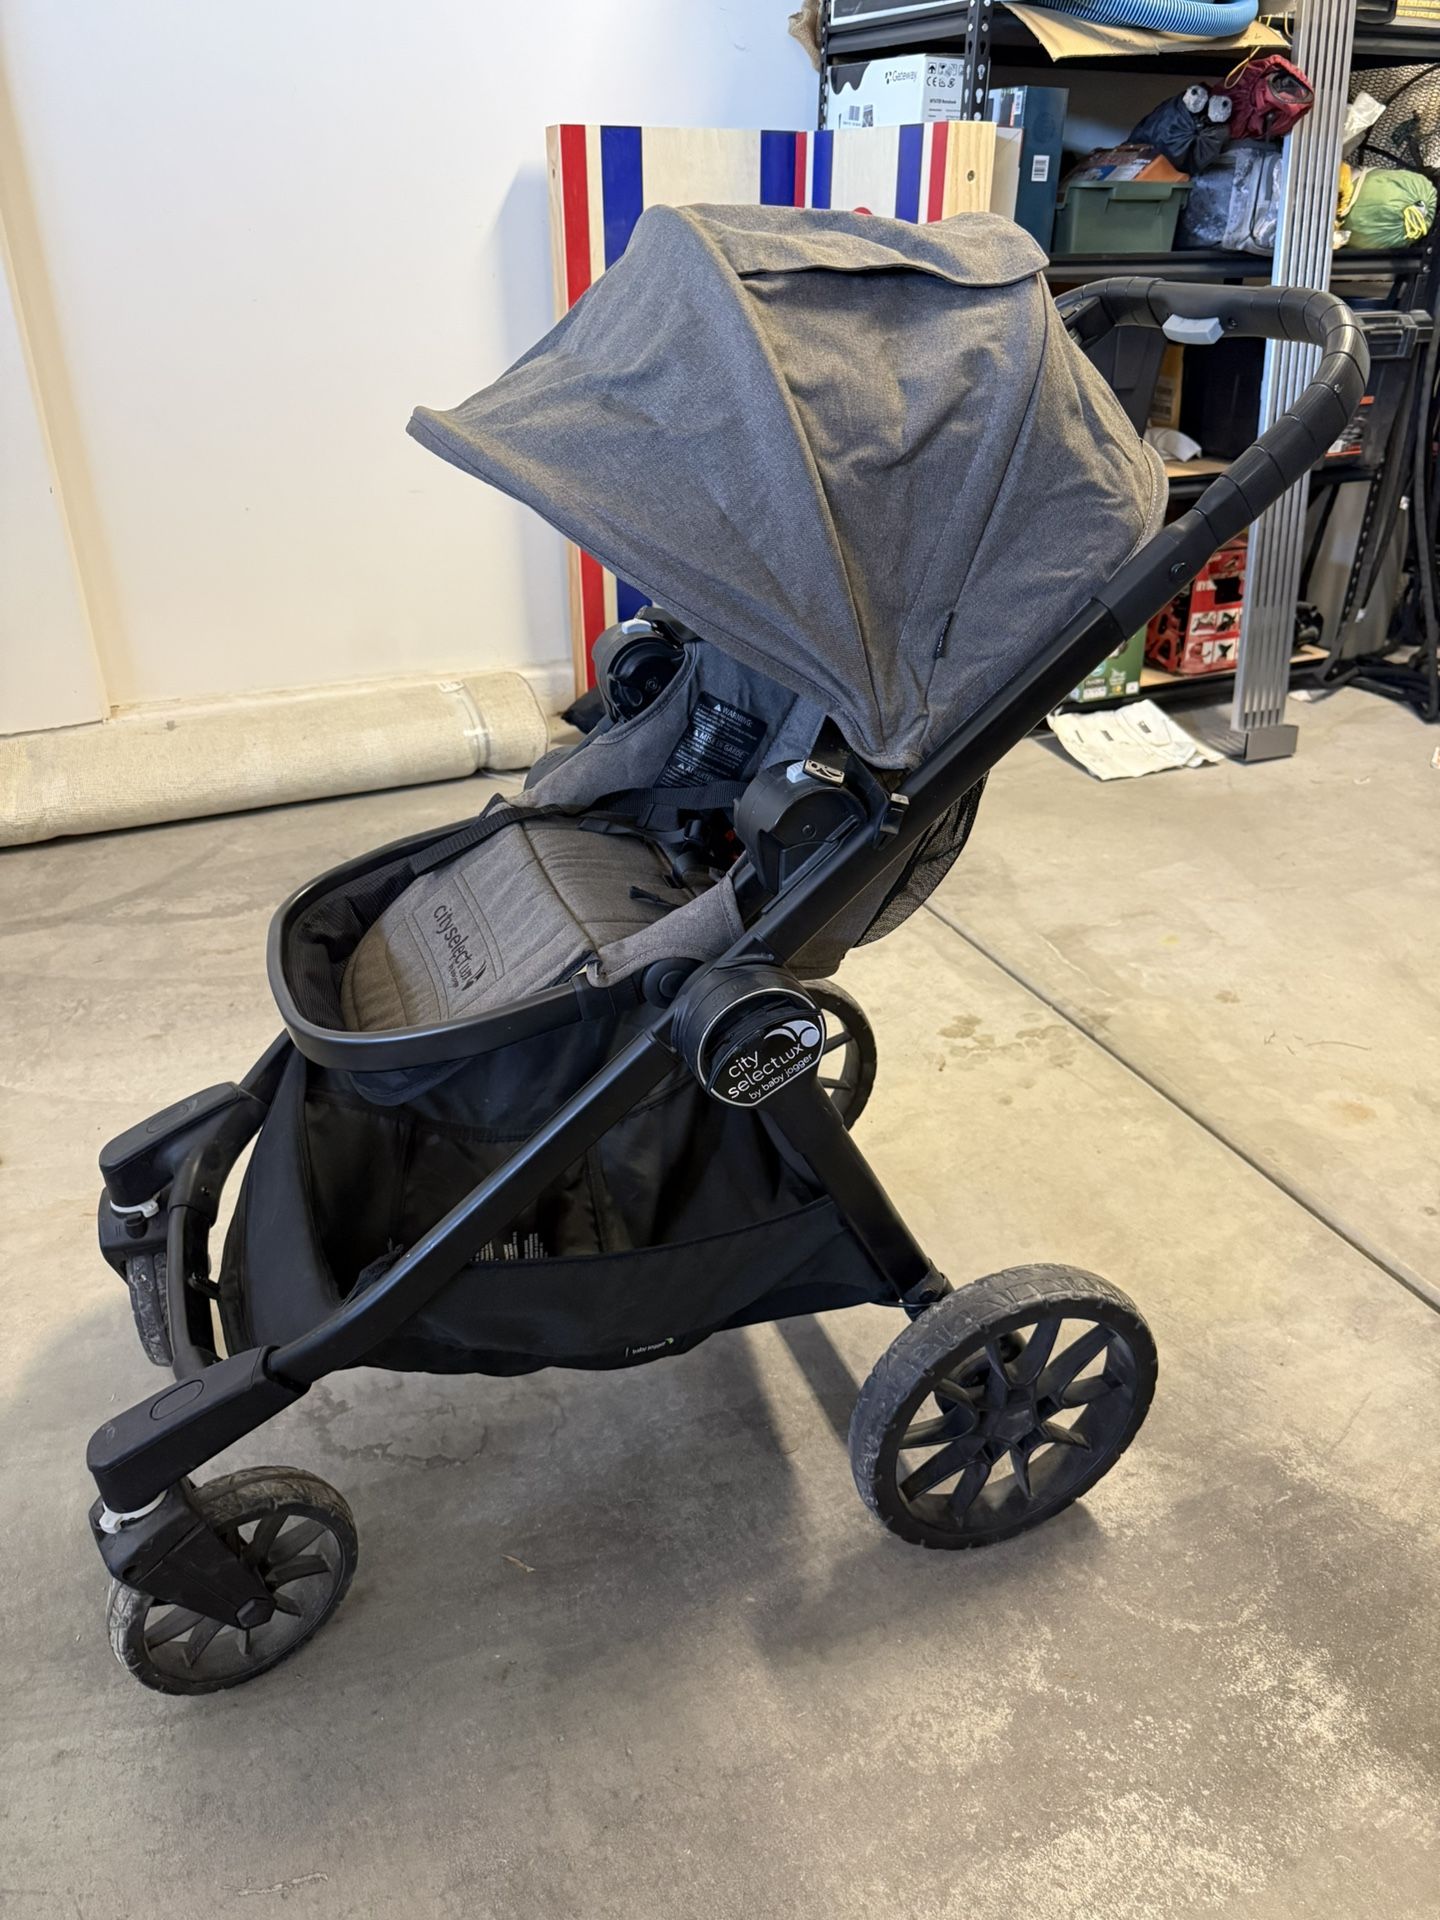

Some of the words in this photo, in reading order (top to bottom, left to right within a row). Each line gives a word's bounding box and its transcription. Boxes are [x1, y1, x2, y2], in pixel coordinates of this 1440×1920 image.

[727, 1057, 780, 1099] select
[778, 1042, 804, 1064] LUX
[728, 1050, 759, 1078] city
[748, 1088, 762, 1100] by
[761, 1072, 785, 1092] baby
[785, 1053, 813, 1078] jogger
